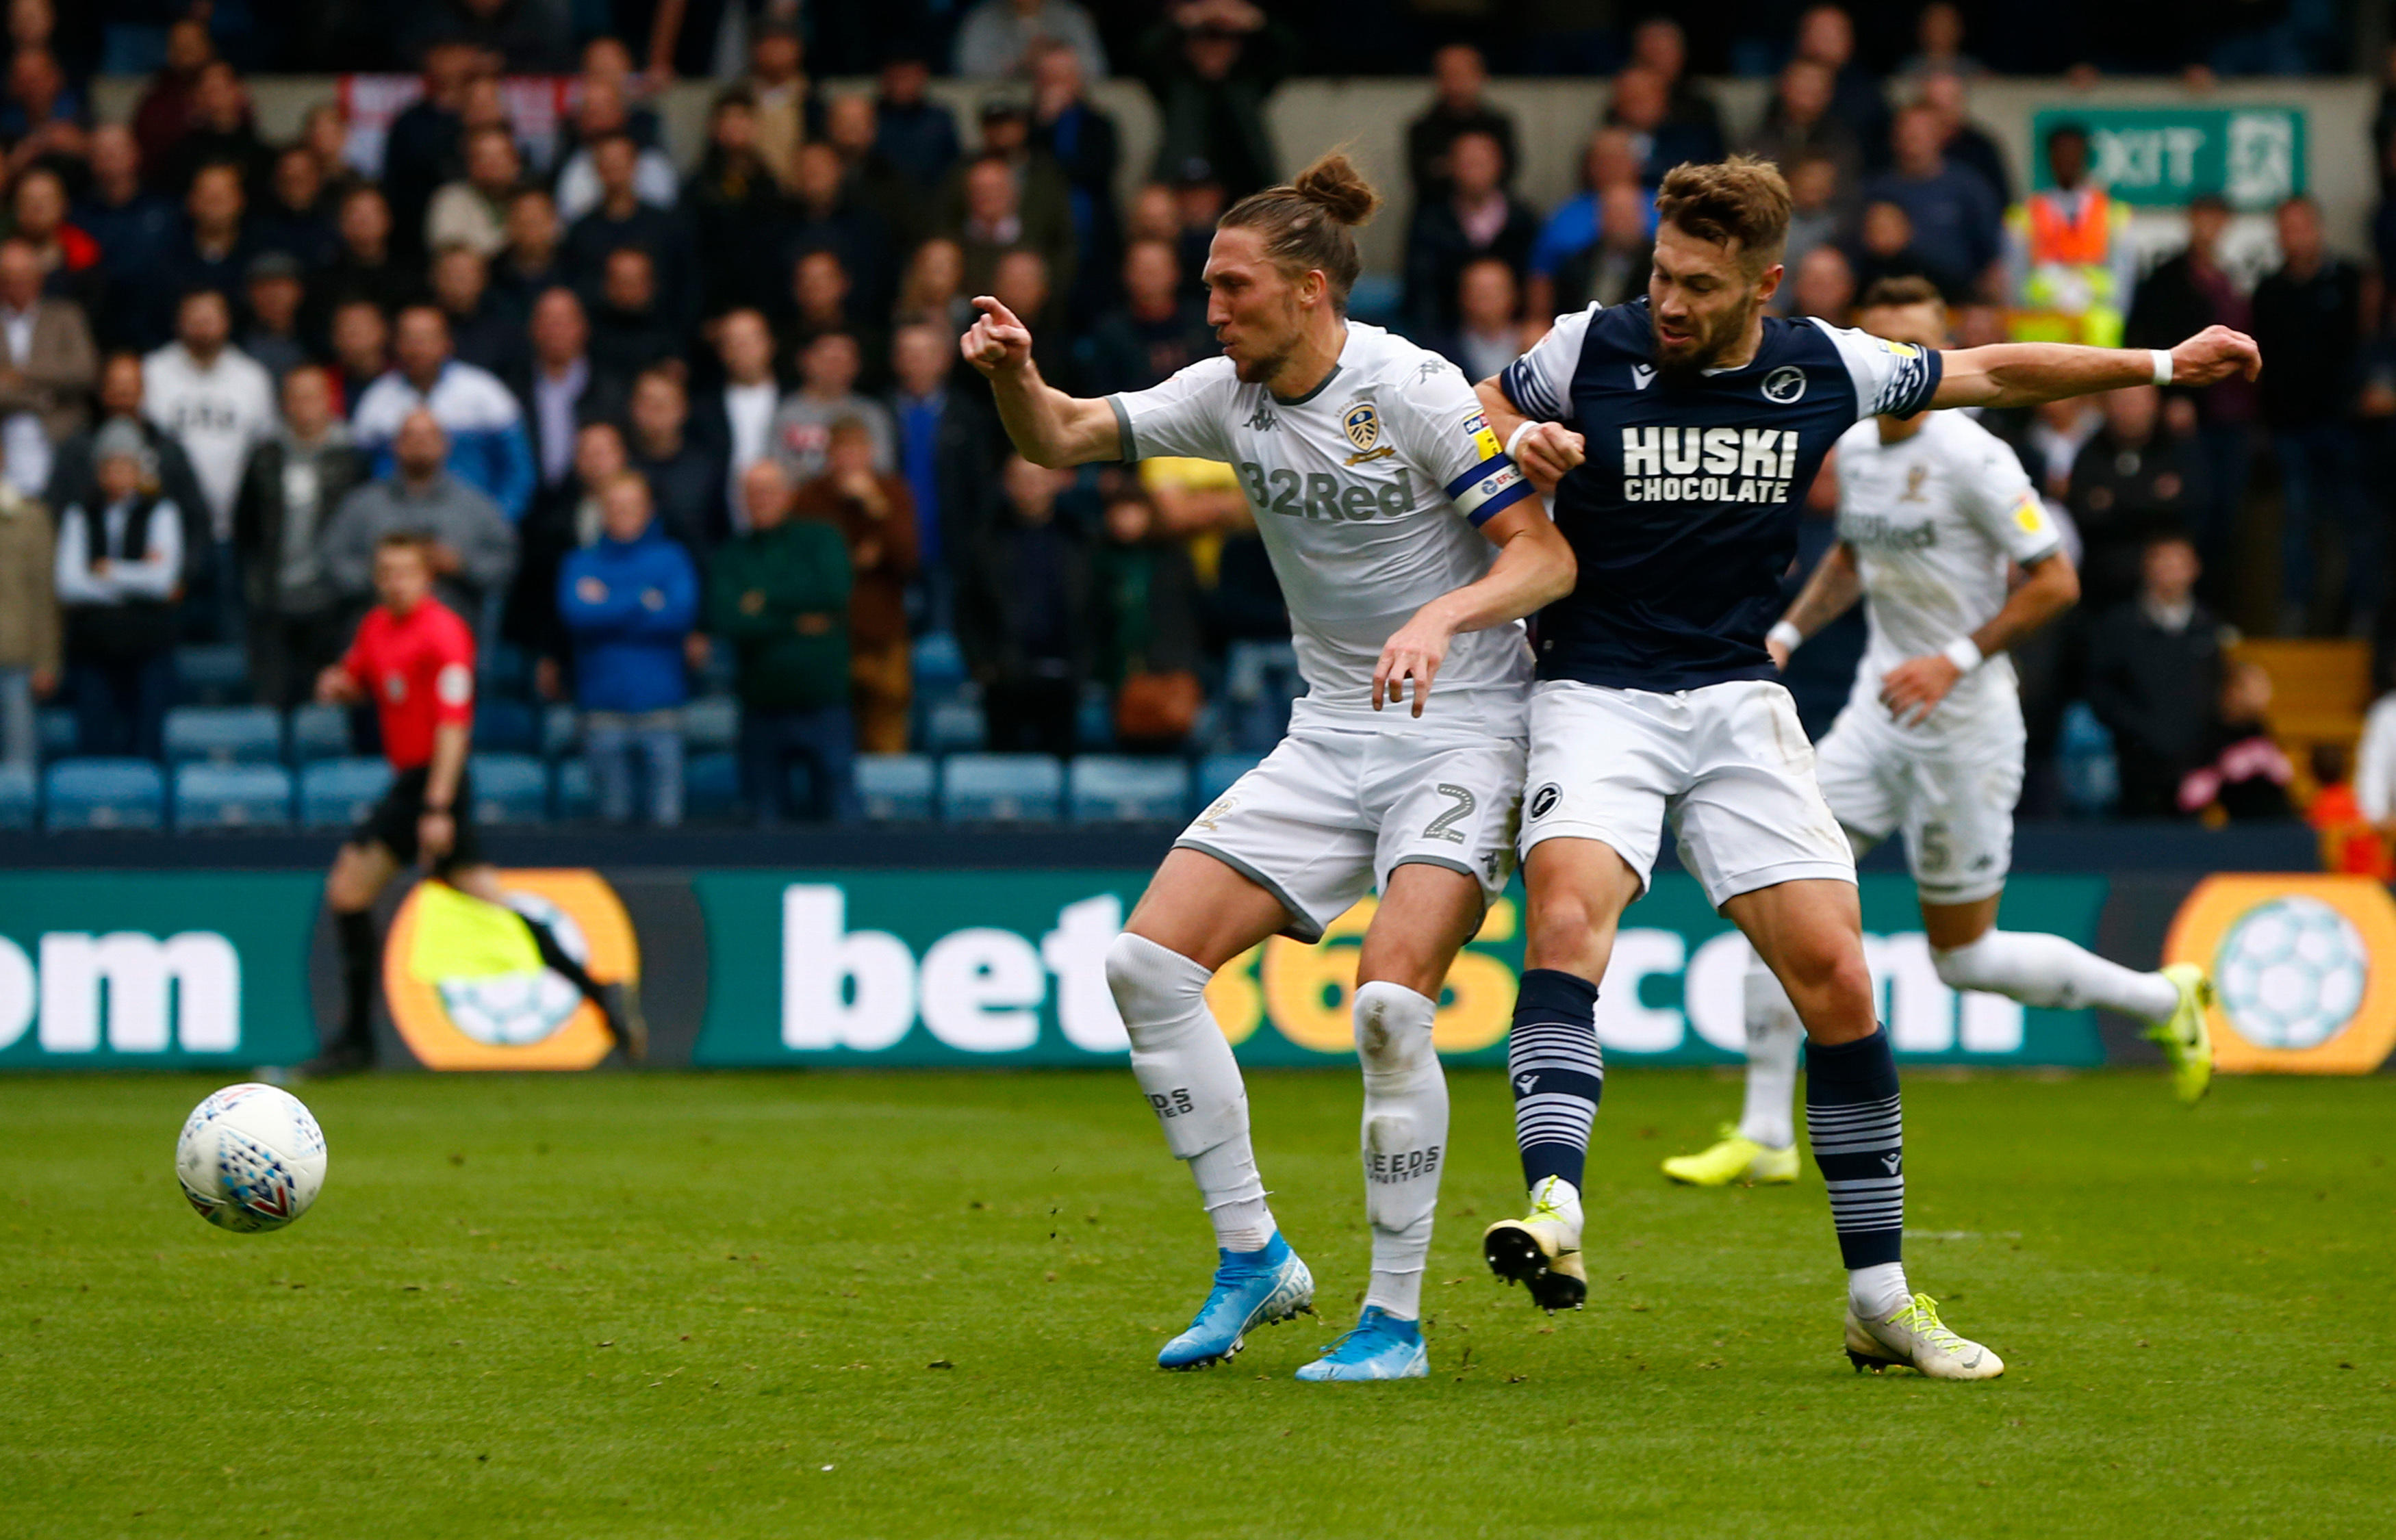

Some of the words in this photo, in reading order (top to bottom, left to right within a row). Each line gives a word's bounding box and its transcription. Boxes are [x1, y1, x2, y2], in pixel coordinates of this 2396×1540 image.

[2089, 126, 2206, 188] XIT
[1622, 426, 1799, 479] HUSKI
[1241, 462, 1415, 522] 32Red
[1624, 477, 1791, 503] CHOCOLATE
[1422, 784, 1476, 845] 2
[1921, 823, 1951, 873] 5
